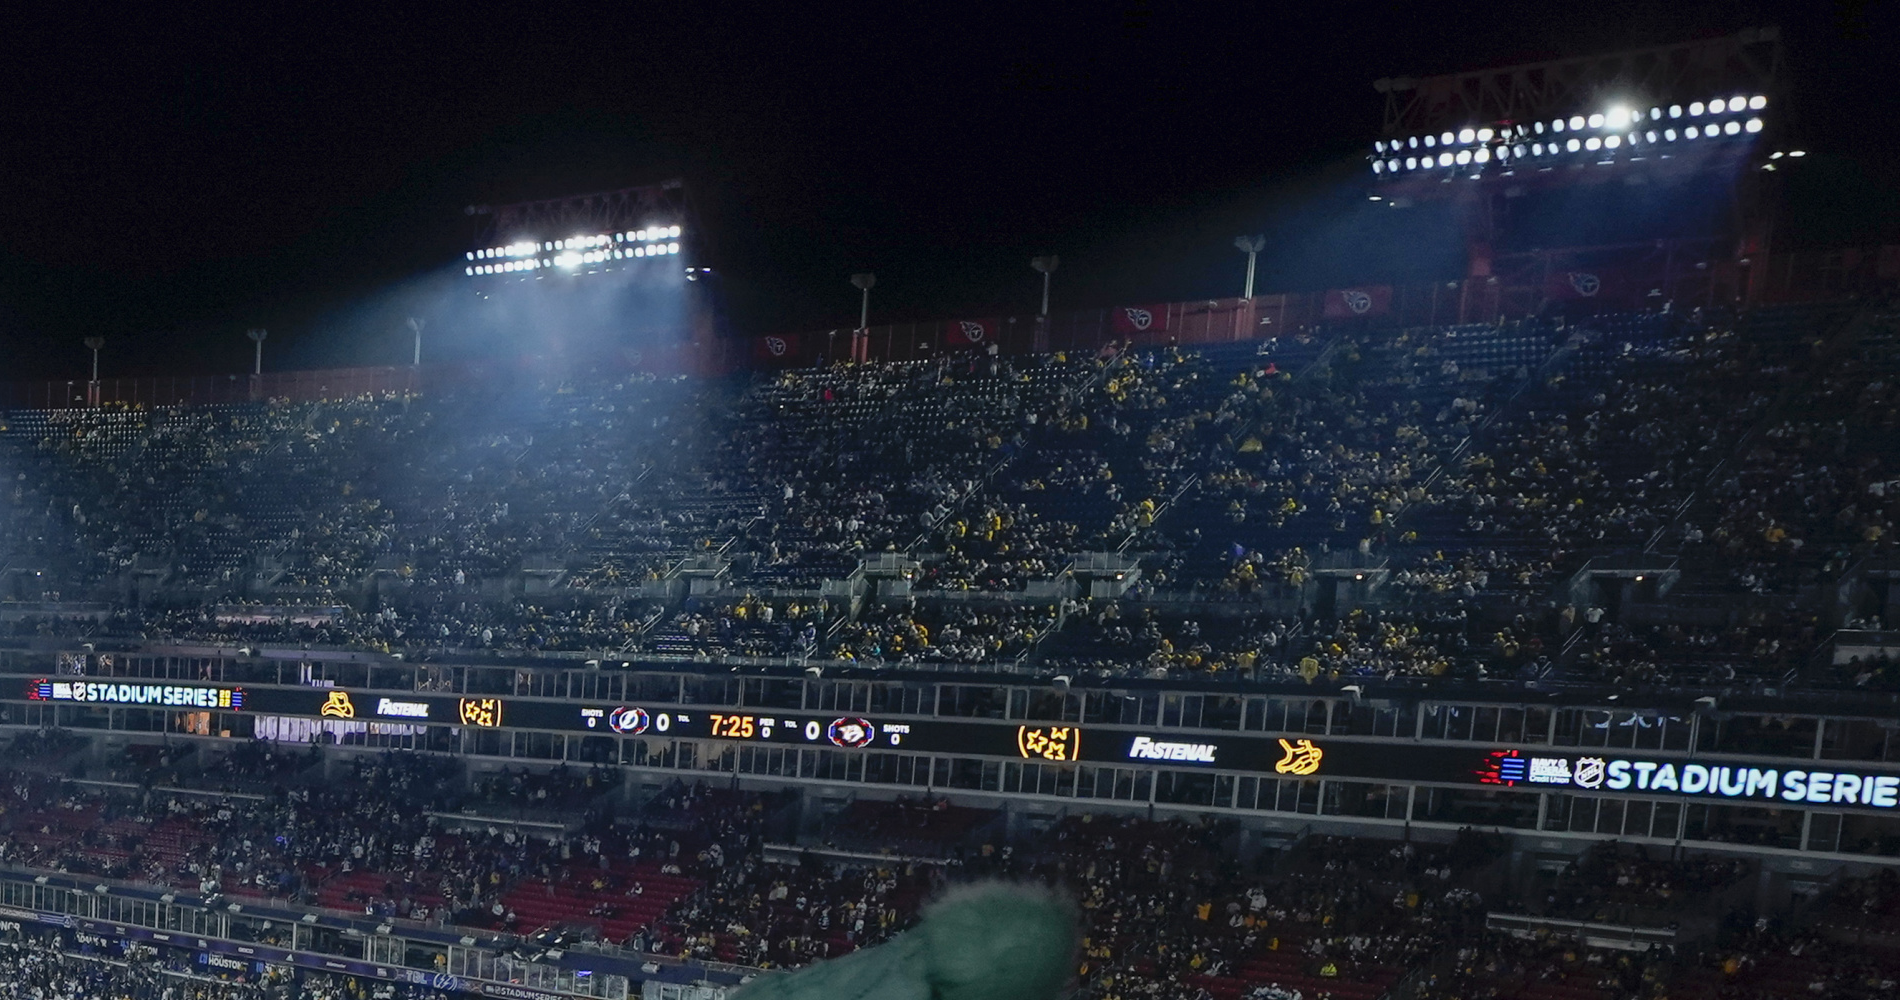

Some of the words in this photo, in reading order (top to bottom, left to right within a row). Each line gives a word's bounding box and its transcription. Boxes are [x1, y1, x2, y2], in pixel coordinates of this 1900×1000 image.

[87, 683, 162, 704] STADIUM
[163, 687, 218, 707] SERIES
[377, 698, 429, 717] FASTENAL
[581, 708, 603, 717] SHOTS
[588, 717, 596, 728] 0
[656, 713, 670, 732] 0
[710, 714, 754, 738] 7:25
[883, 724, 910, 733] SHOTS
[761, 727, 771, 738] 0
[805, 721, 820, 740] 0
[890, 733, 900, 745] 0
[1129, 736, 1216, 763] FASTENAL
[1531, 757, 1558, 766] NAVY
[1606, 760, 1778, 798] STADIUM
[1781, 769, 1900, 807] SERIE
[208, 956, 243, 970] HOUSTON
[406, 970, 428, 984] TBL
[501, 987, 535, 1000] STADIUM
